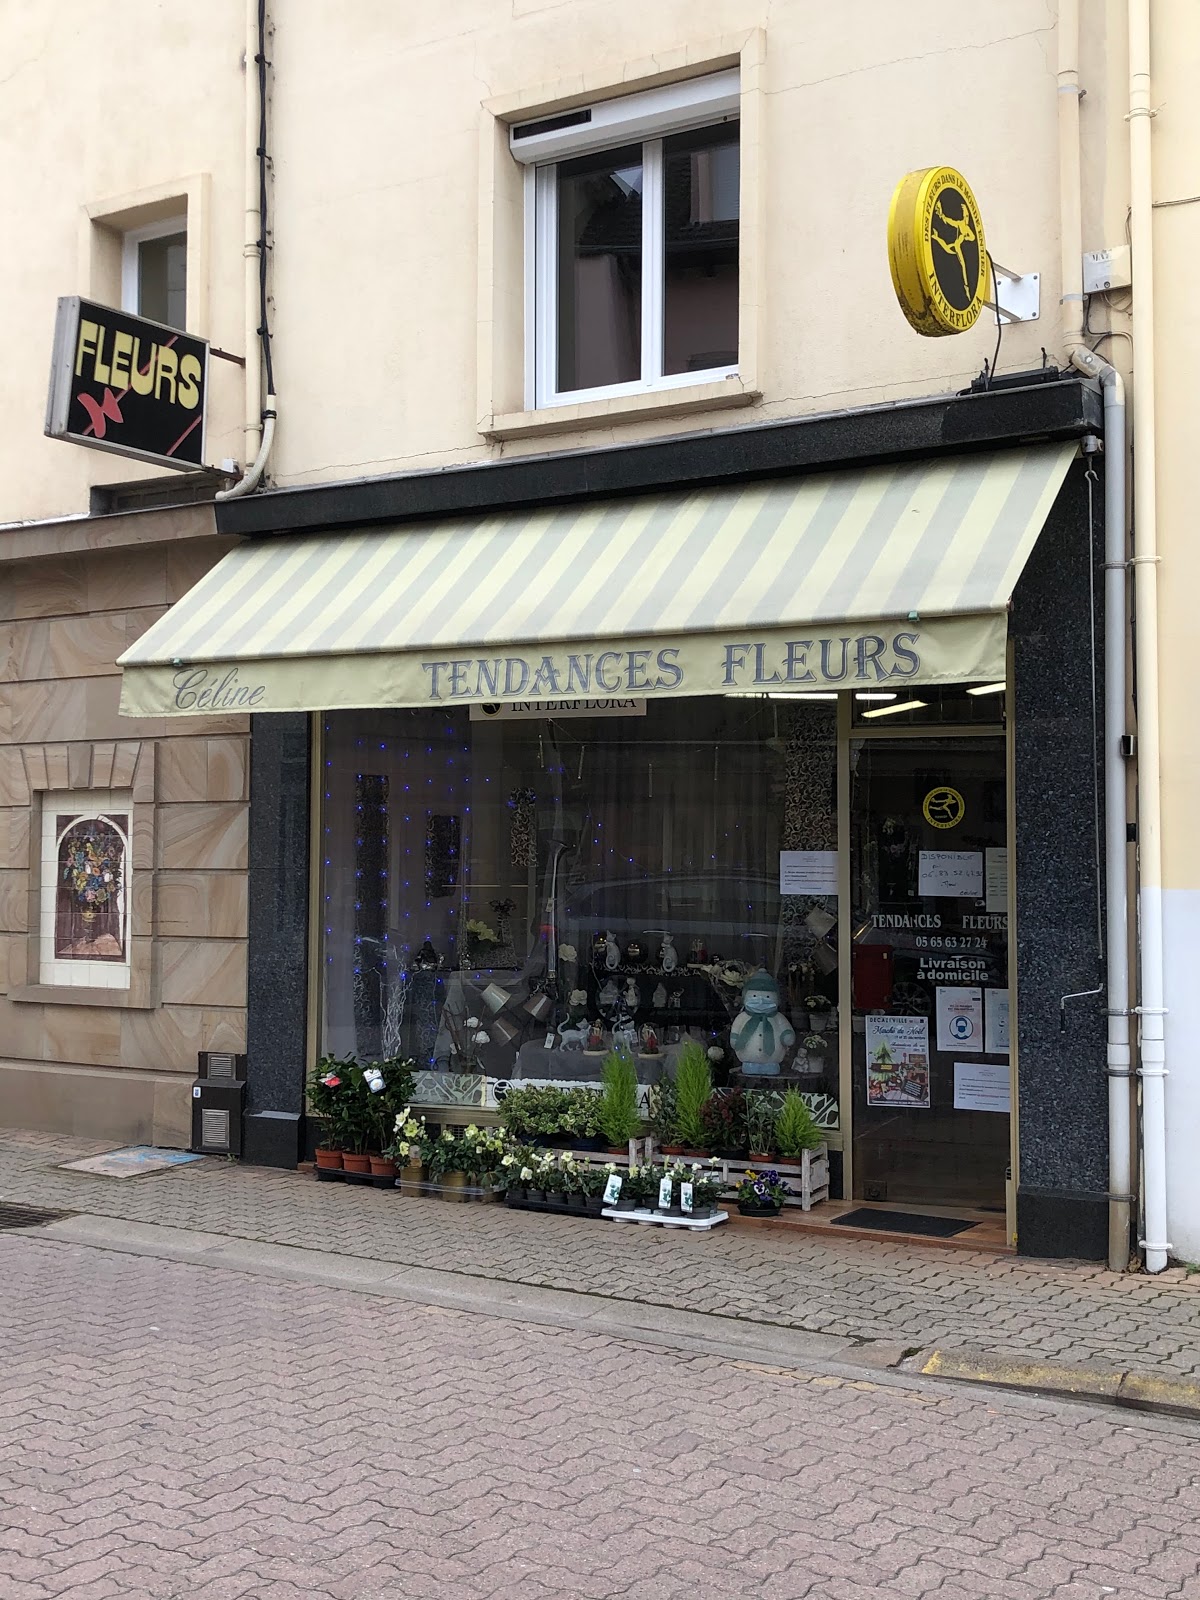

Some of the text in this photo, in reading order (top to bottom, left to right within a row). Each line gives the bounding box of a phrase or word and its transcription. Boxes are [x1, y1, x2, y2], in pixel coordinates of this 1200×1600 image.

[925, 178, 941, 214] FLEURS
[941, 174, 956, 185] DANS
[956, 177, 964, 191] LE
[963, 188, 981, 227] MONDE
[929, 272, 983, 328] INTERFLORA
[75, 318, 202, 410] FLEURS
[421, 632, 921, 700] TENDANCES FLEURS
[172, 667, 266, 710] Céline
[871, 914, 1008, 930] TENDANCES FLEURS
[915, 936, 988, 949] 05 65 63 27 24
[917, 968, 989, 981] à domicile
[920, 957, 986, 969] Livraison
